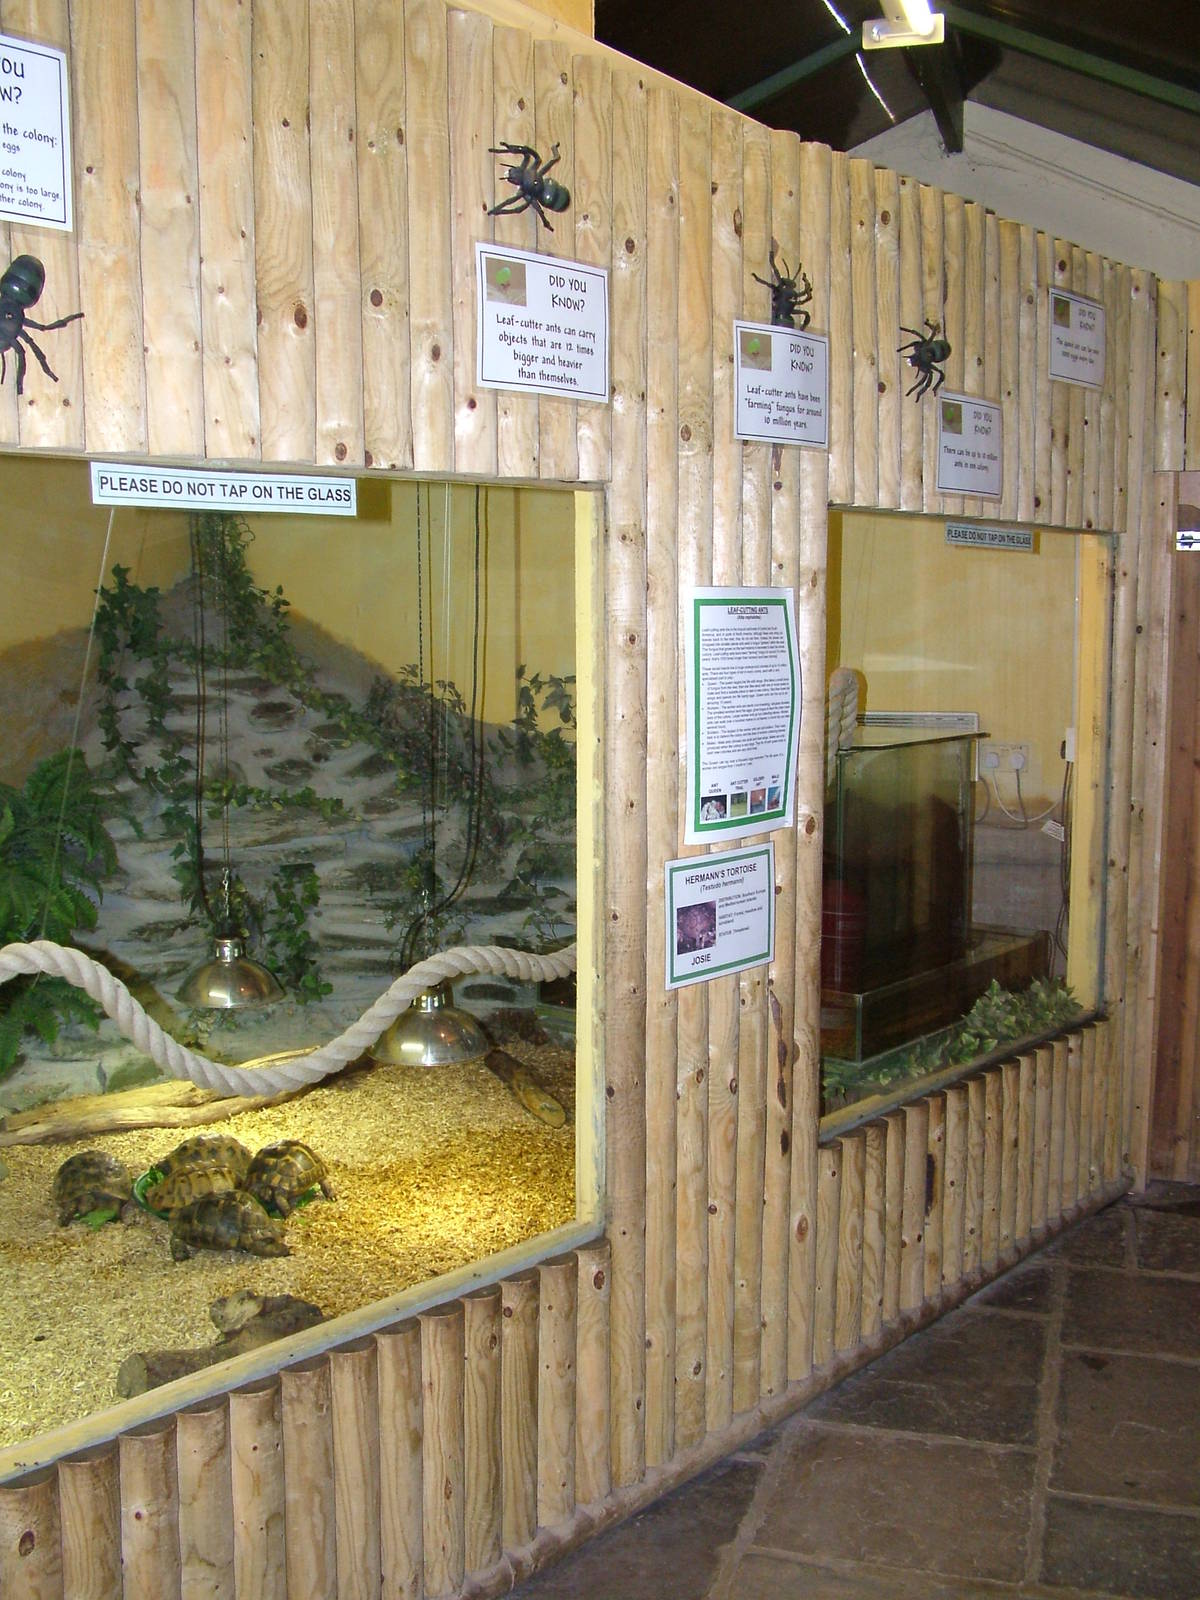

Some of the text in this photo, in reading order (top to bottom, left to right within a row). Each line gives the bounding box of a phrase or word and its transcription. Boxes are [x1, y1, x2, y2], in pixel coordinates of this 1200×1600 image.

[0, 57, 25, 79] OU
[2, 122, 58, 148] the colony:
[2, 142, 20, 154] eggs
[2, 168, 26, 182] colony
[17, 185, 24, 193] is
[26, 186, 38, 196] too
[549, 274, 587, 293] DID YOU
[551, 294, 585, 312] KNOW?
[496, 313, 596, 343] Leaf-cutter ants can carry
[498, 330, 594, 356] objects that are 12 times
[790, 343, 814, 358] DID YOU
[514, 350, 583, 370] bigger and heavier
[790, 360, 814, 374] KNOW?
[518, 367, 579, 386] than themselves.
[746, 384, 783, 398] Leaf-cutter
[784, 390, 796, 399] ants
[776, 402, 795, 416] fungus
[796, 405, 805, 414] for
[806, 406, 822, 417] around
[764, 416, 770, 424] 10
[772, 416, 792, 427] million
[100, 476, 352, 502] PLEASE DO NOT TAP ON THE GLASS
[947, 528, 968, 540] PLEASE
[968, 530, 976, 540] DO
[977, 531, 987, 540] NOT
[988, 532, 997, 542] TAP
[998, 534, 1006, 542] ON
[1006, 535, 1015, 544] THE
[685, 863, 757, 885] HERMANN'S TORTOISE
[691, 953, 711, 966] JOSIE
